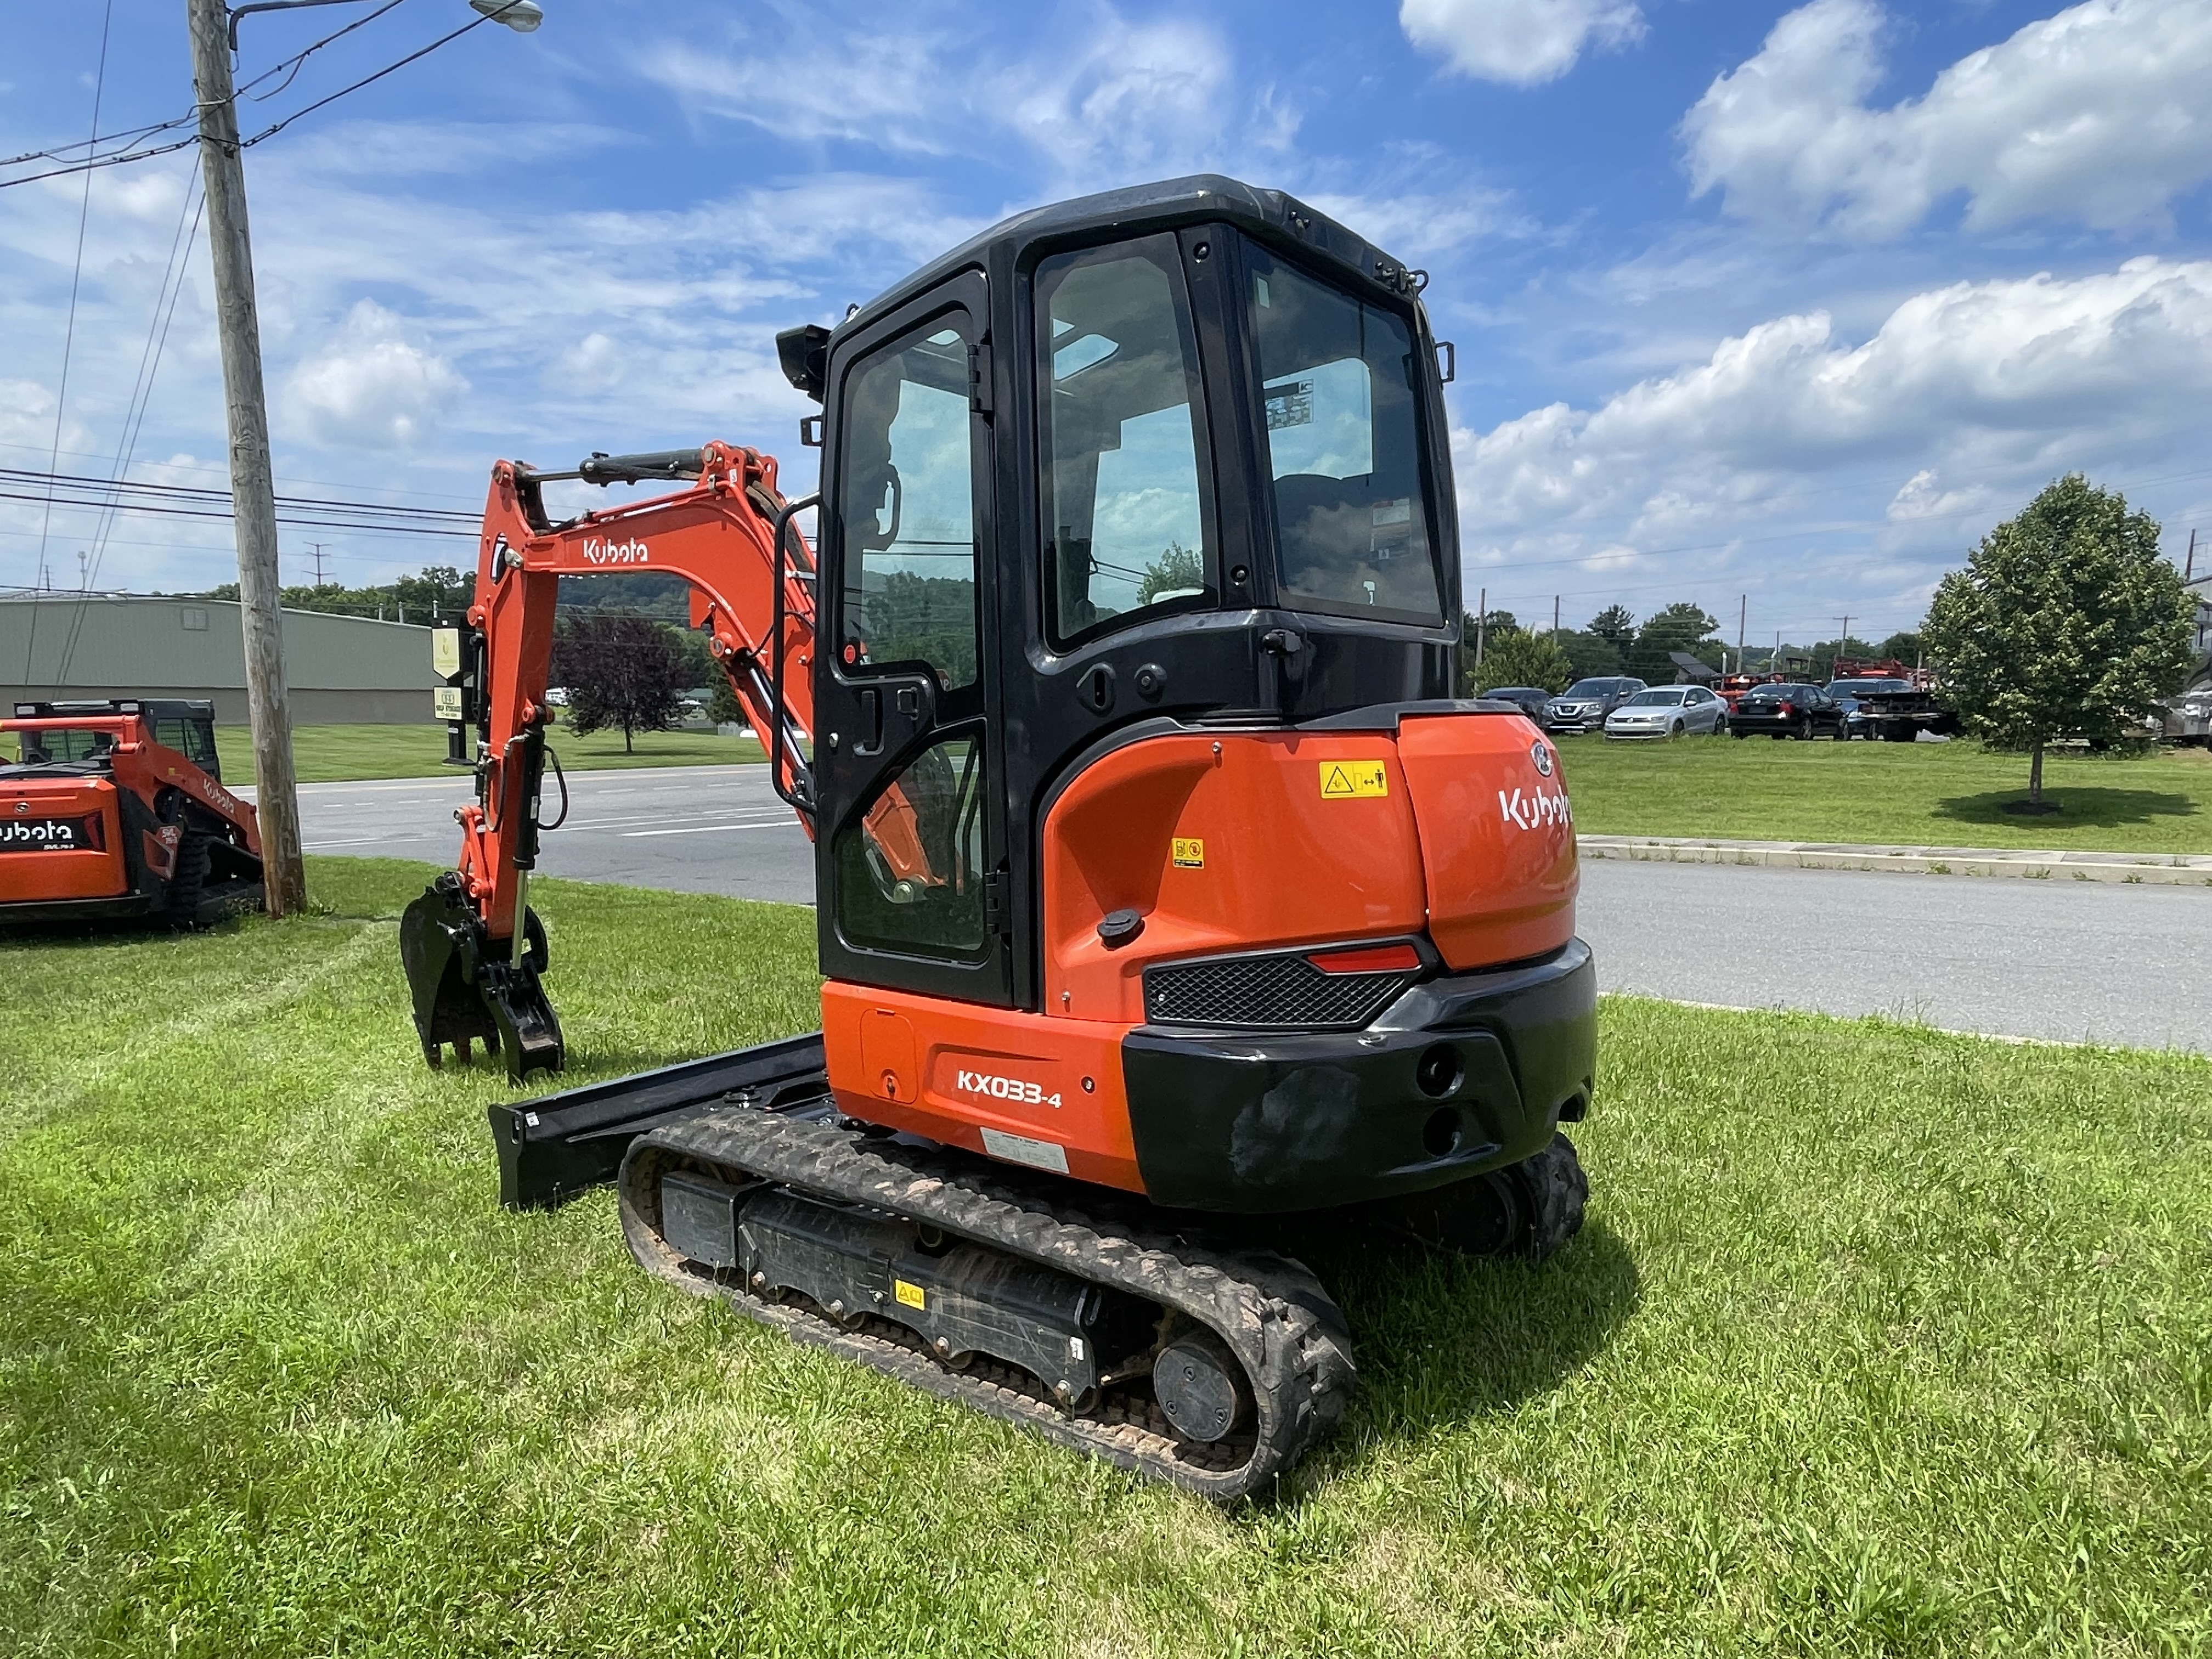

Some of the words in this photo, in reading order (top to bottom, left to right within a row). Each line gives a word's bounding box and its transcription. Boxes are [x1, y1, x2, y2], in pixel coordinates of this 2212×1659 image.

[583, 537, 647, 564] Kubota
[204, 778, 234, 814] Kubota
[0, 821, 72, 841] ubota
[958, 1070, 1062, 1108] KX033-4
